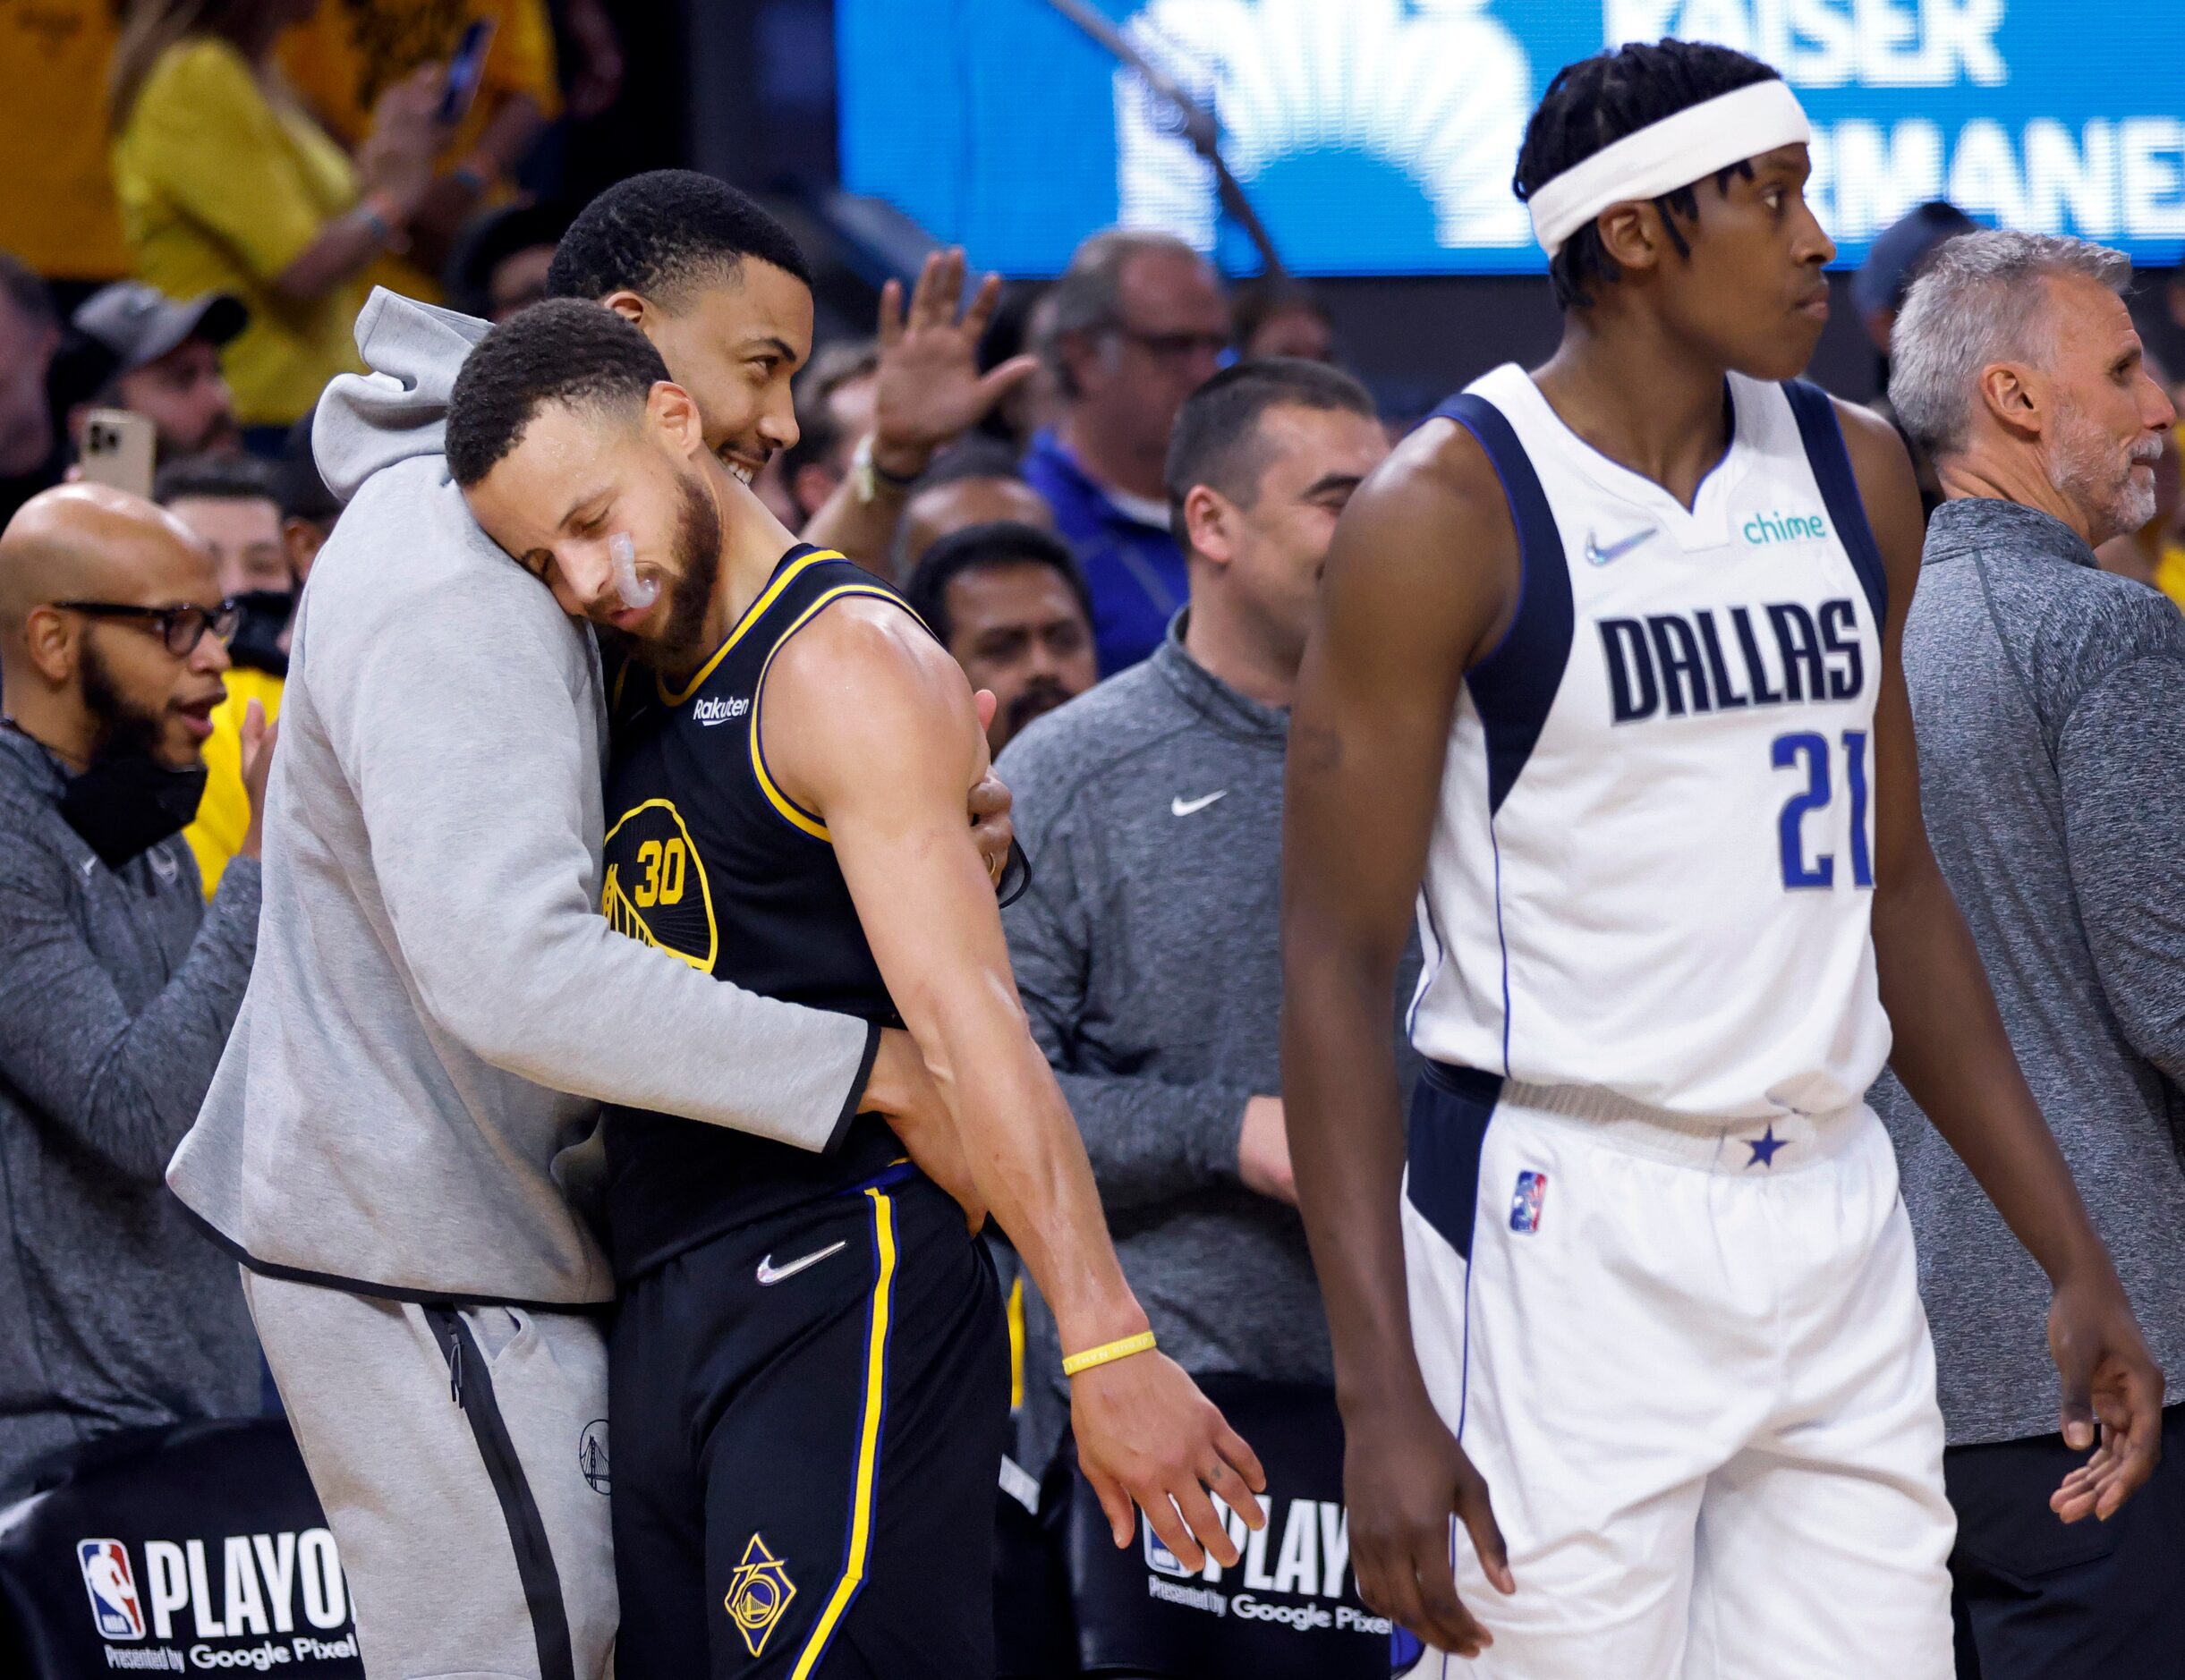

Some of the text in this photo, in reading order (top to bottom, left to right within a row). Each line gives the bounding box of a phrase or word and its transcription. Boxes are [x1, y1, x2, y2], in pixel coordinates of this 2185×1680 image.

[1744, 510, 1826, 544] chime
[1595, 598, 1864, 726] DALLAS
[693, 696, 750, 721] Rakuten
[1771, 729, 1875, 893] 21
[634, 837, 685, 908] 30
[1201, 1490, 1364, 1599] PLAY
[143, 1527, 356, 1639] PLAYO
[1230, 1593, 1332, 1631] Google
[190, 1641, 292, 1671] Google
[292, 1633, 358, 1662] Pixel
